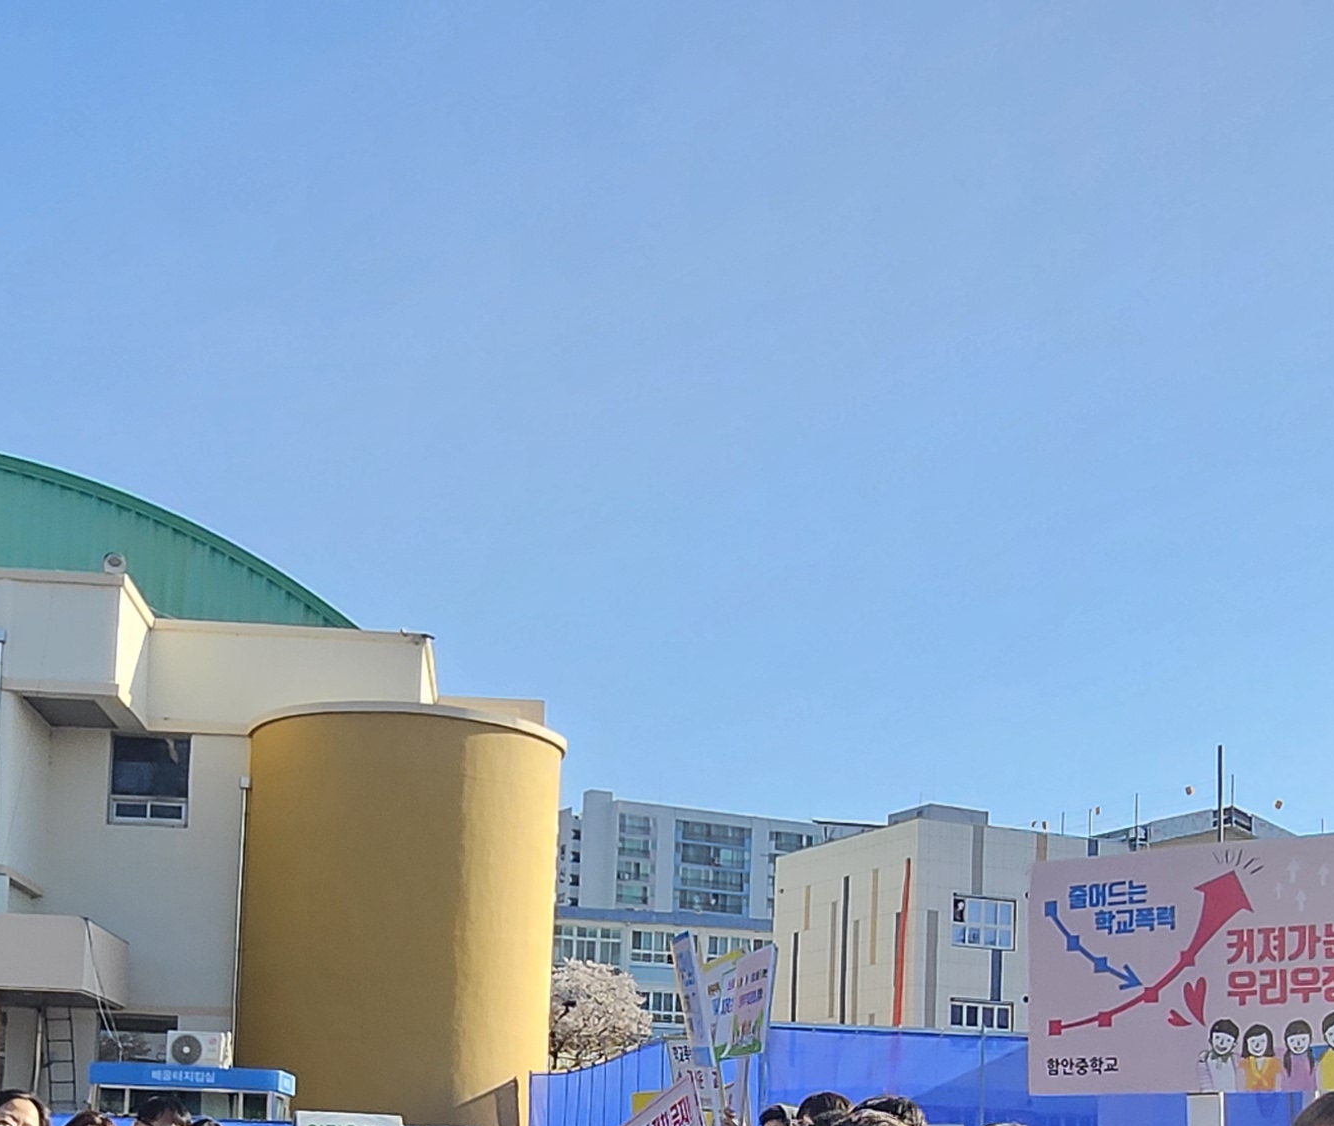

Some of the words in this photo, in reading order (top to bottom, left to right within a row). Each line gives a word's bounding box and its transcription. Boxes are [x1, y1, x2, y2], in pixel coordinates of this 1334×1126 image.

[1069, 880, 1148, 910] 줄어드는
[1095, 904, 1175, 936] 학교폭력
[1046, 1056, 1119, 1076] 함안중학교
